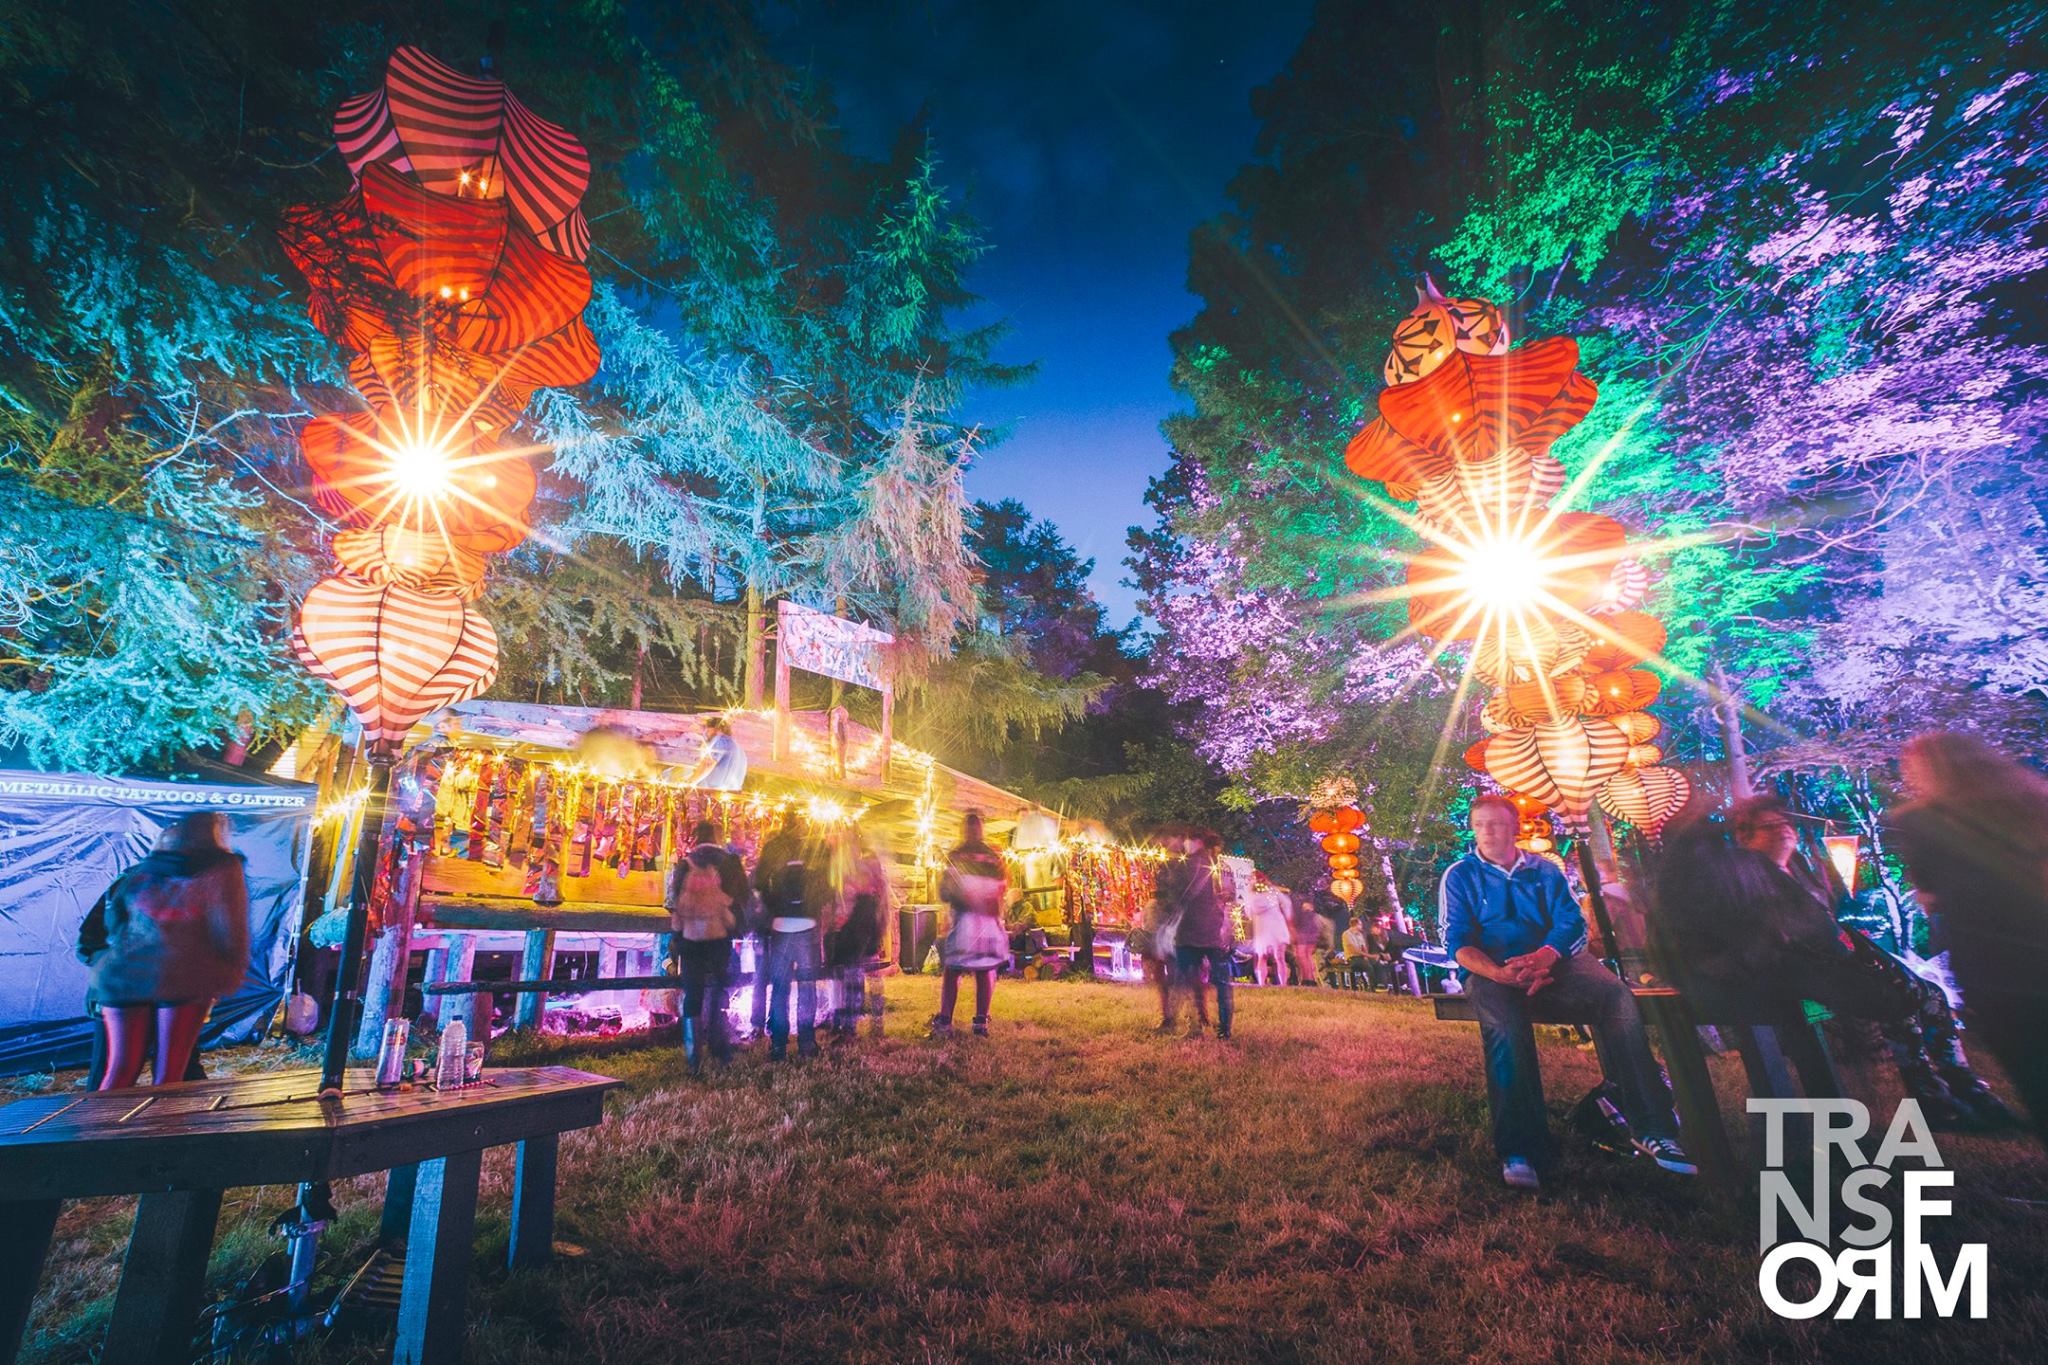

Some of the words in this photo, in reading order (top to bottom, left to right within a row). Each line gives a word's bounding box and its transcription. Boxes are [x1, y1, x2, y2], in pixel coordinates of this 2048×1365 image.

[0, 781, 112, 797] METALLIC
[116, 787, 206, 803] TATTOOS
[209, 792, 224, 804] &
[227, 793, 306, 807] GLITTER
